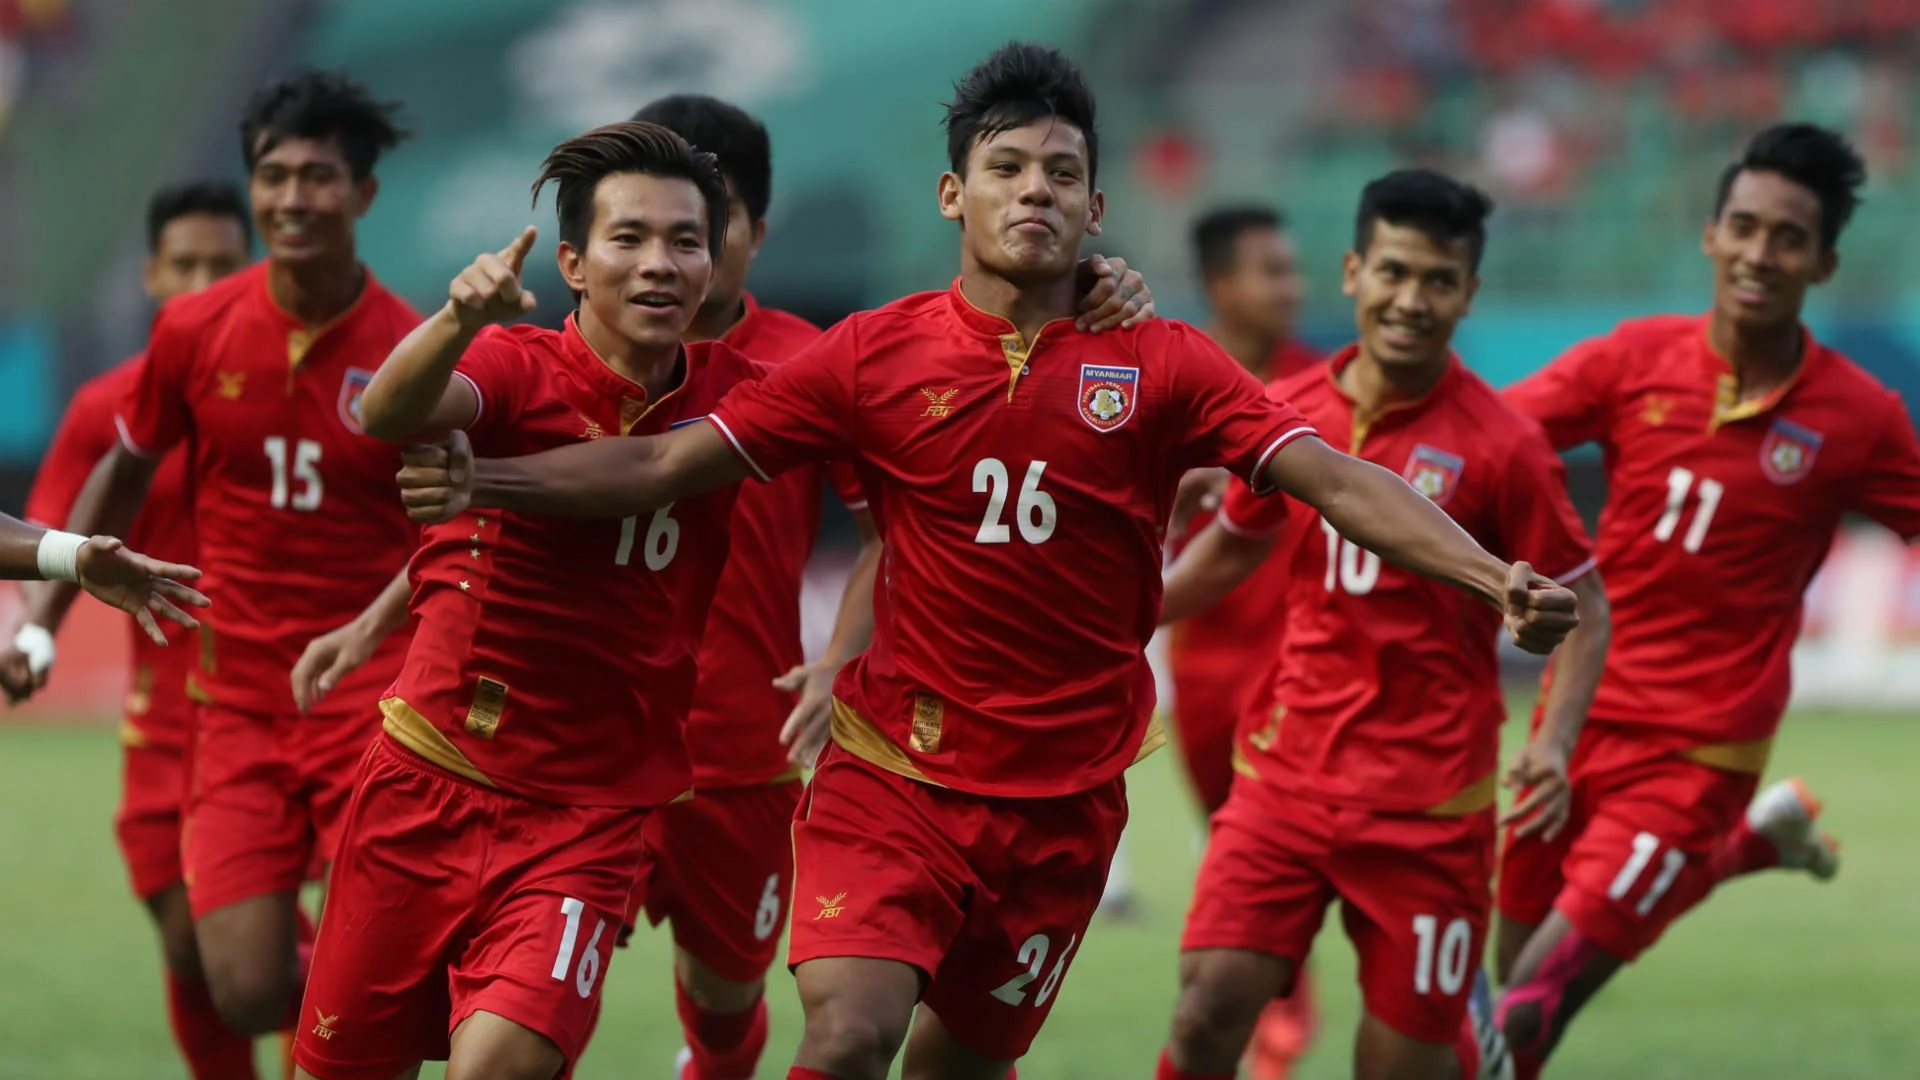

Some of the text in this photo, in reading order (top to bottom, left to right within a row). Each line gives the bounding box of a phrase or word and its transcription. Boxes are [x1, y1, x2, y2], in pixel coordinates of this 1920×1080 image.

[920, 405, 955, 417] FBT
[1085, 369, 1132, 380] MYANMAR
[264, 436, 324, 511] 15
[972, 457, 1057, 544] 26
[1653, 467, 1724, 554] 11
[614, 500, 680, 571] 16
[1320, 515, 1382, 595] 10
[754, 873, 780, 940] 6
[1607, 831, 1686, 917] 11
[551, 897, 606, 999] 16
[813, 906, 845, 920] FBT
[989, 932, 1076, 1008] 26
[1413, 914, 1471, 996] 10
